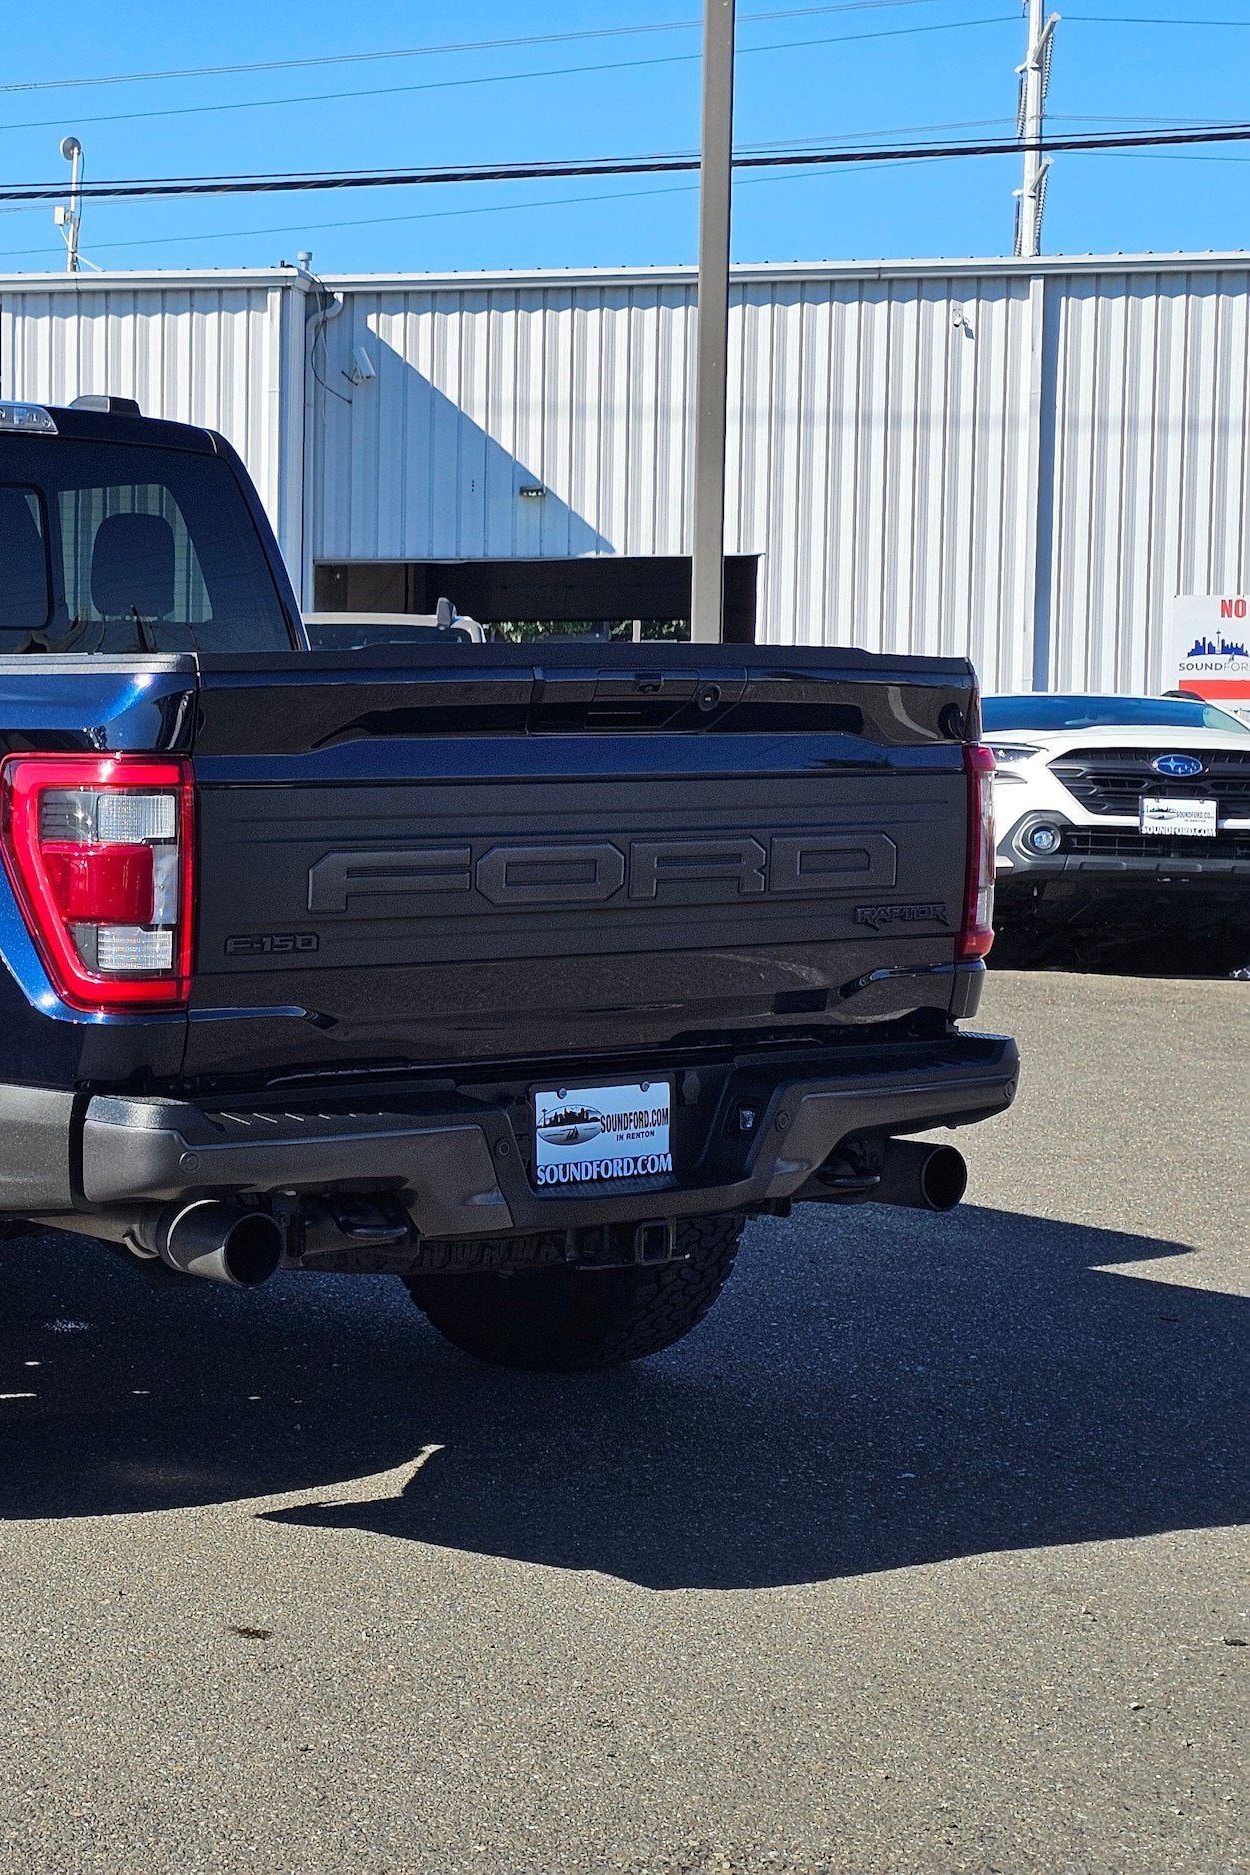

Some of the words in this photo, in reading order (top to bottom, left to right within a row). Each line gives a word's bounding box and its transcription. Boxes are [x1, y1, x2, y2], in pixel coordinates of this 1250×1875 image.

[1220, 599, 1247, 618] NO
[1178, 662, 1250, 671] SOUNDFOR
[1141, 825, 1217, 837] SOUNDFORD.COM
[307, 831, 898, 913] FORD
[855, 902, 950, 930] RAPTOR
[225, 933, 319, 954] F-150
[600, 1107, 669, 1134] SOUNDFORD.COM
[616, 1134, 624, 1142] IN
[626, 1130, 655, 1140] RENTON
[536, 1152, 673, 1186] SOUNDFORD.COM
